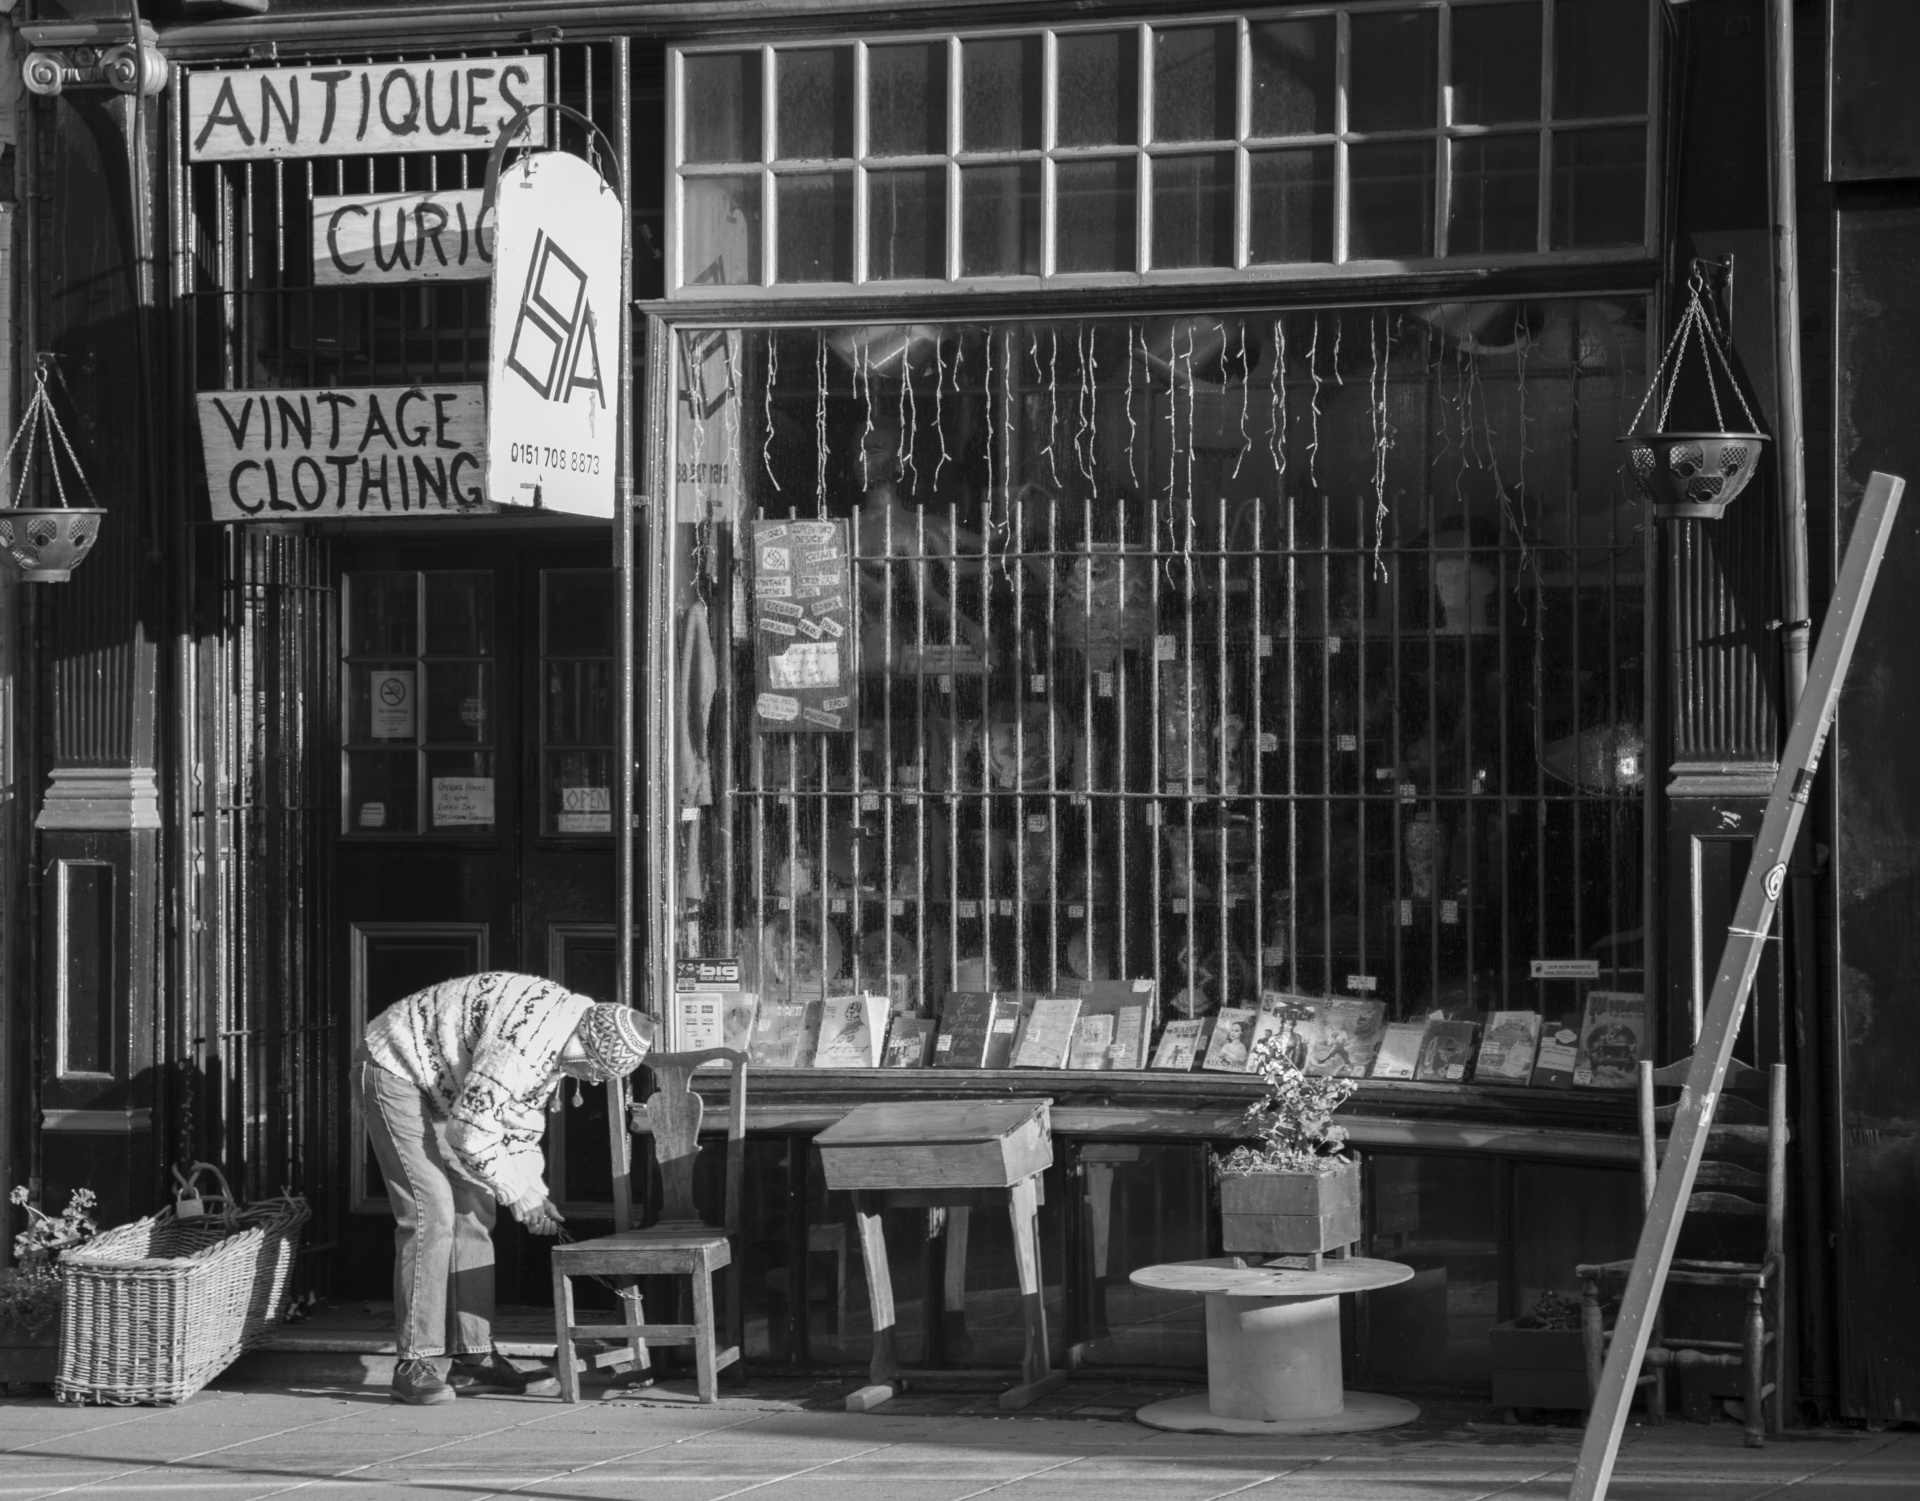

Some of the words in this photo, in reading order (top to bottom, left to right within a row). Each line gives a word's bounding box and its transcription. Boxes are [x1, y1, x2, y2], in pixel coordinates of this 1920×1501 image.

[194, 65, 530, 154] ANTIQUES
[213, 388, 463, 452] VINTAGE
[511, 441, 539, 465] 0151
[544, 445, 567, 470] 708
[571, 448, 601, 476] 8873
[229, 451, 484, 515] CLOTHING
[755, 579, 788, 587] VINTAGE
[767, 601, 800, 617] RECORDS
[813, 598, 839, 613] BOOKS
[761, 620, 793, 634] AFRICAN
[438, 782, 463, 791] OPENING
[465, 782, 486, 791] HOURS
[437, 803, 459, 811] EVERY
[462, 803, 478, 811] DAY
[566, 789, 608, 810] OPEN
[700, 963, 739, 981] big
[961, 993, 977, 1008] The
